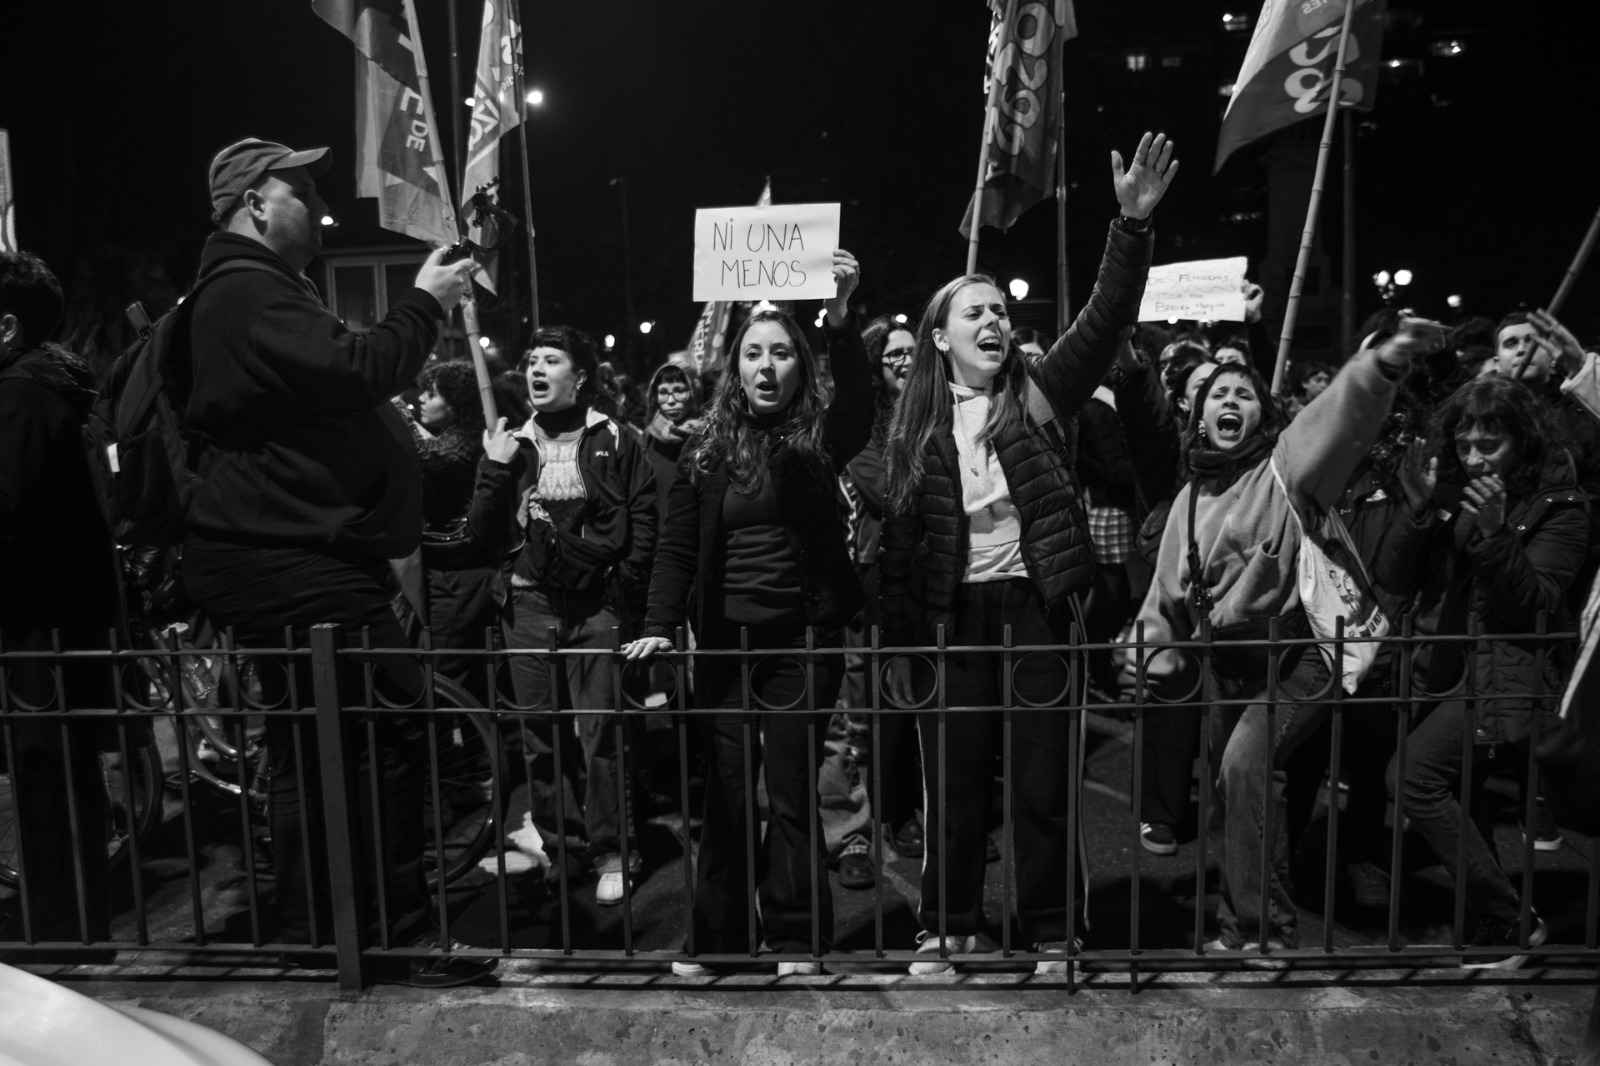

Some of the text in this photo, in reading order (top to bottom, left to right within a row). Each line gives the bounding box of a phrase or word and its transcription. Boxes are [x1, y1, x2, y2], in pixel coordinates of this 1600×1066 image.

[406, 120, 429, 153] DE
[747, 223, 804, 252] UNA
[721, 259, 807, 289] MENOS
